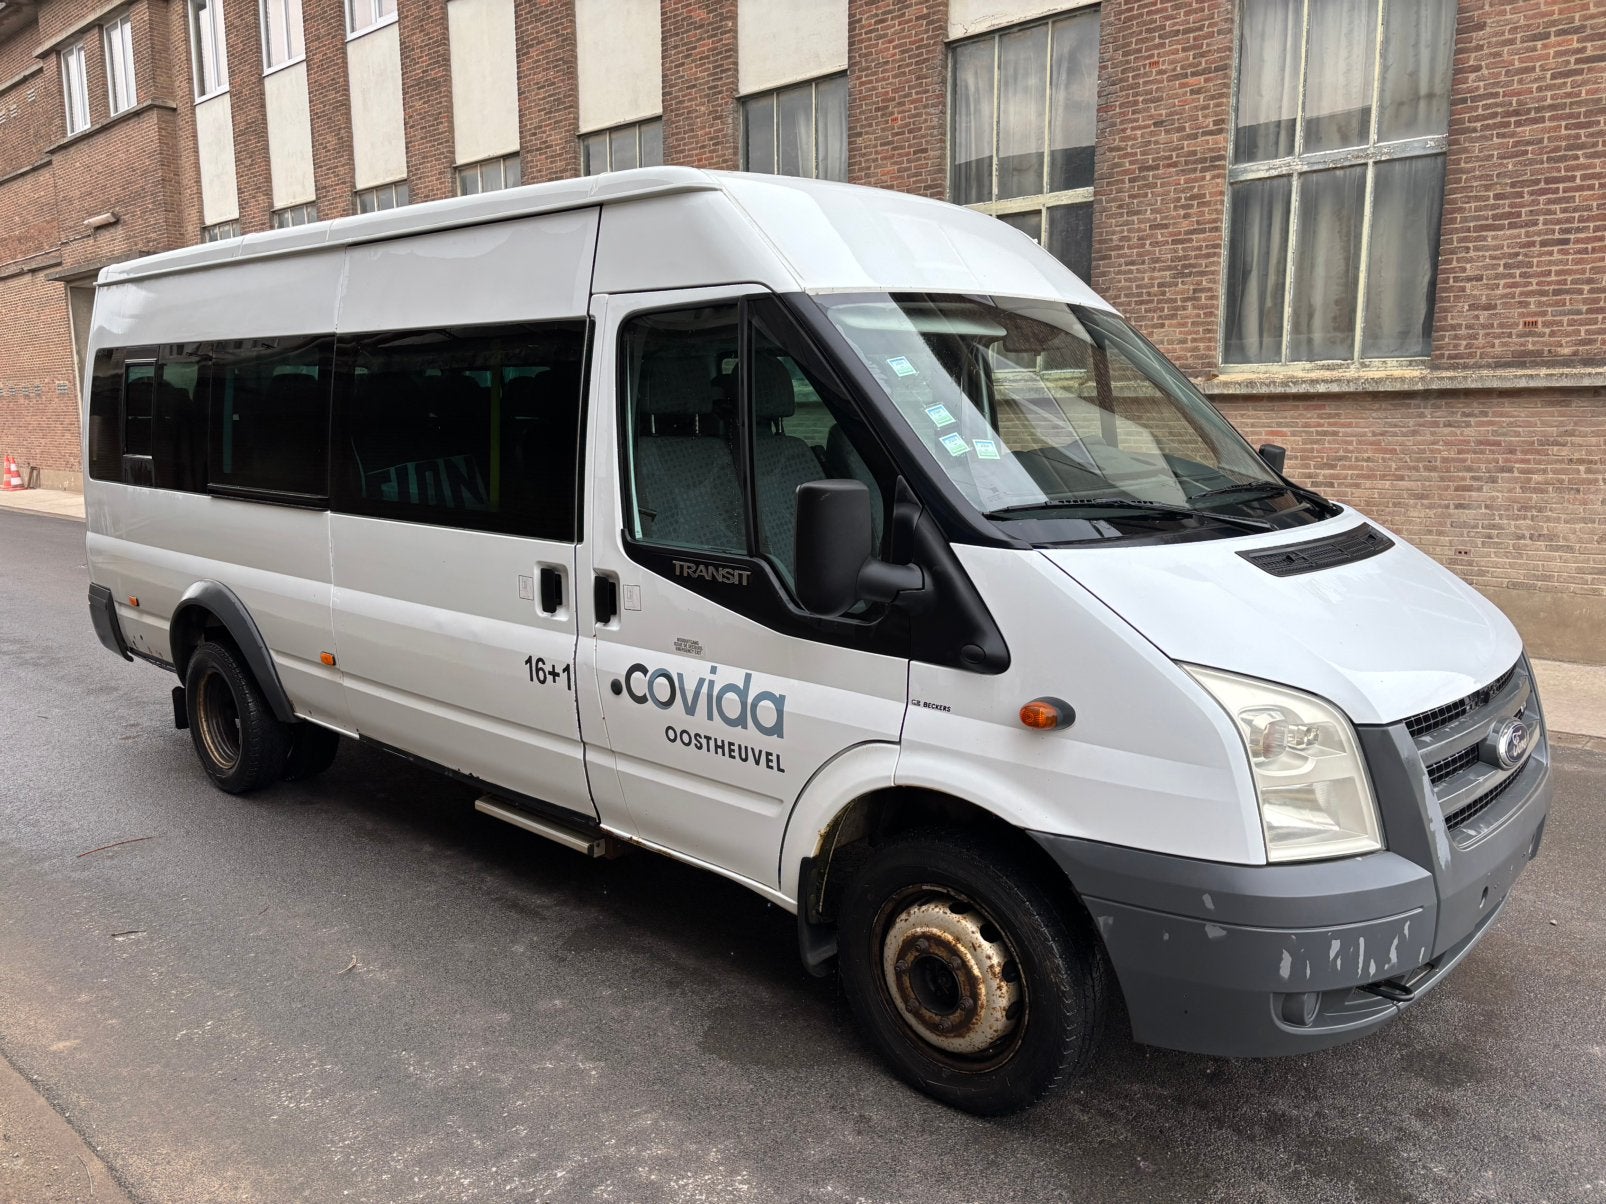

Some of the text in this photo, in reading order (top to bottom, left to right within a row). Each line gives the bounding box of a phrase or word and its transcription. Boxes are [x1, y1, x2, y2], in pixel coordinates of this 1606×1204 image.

[672, 560, 752, 587] TRANSIT
[524, 655, 572, 691] 16+1
[624, 663, 786, 739] covida
[922, 701, 952, 713] BECKERS
[665, 725, 786, 773] OOSTHEUVEL
